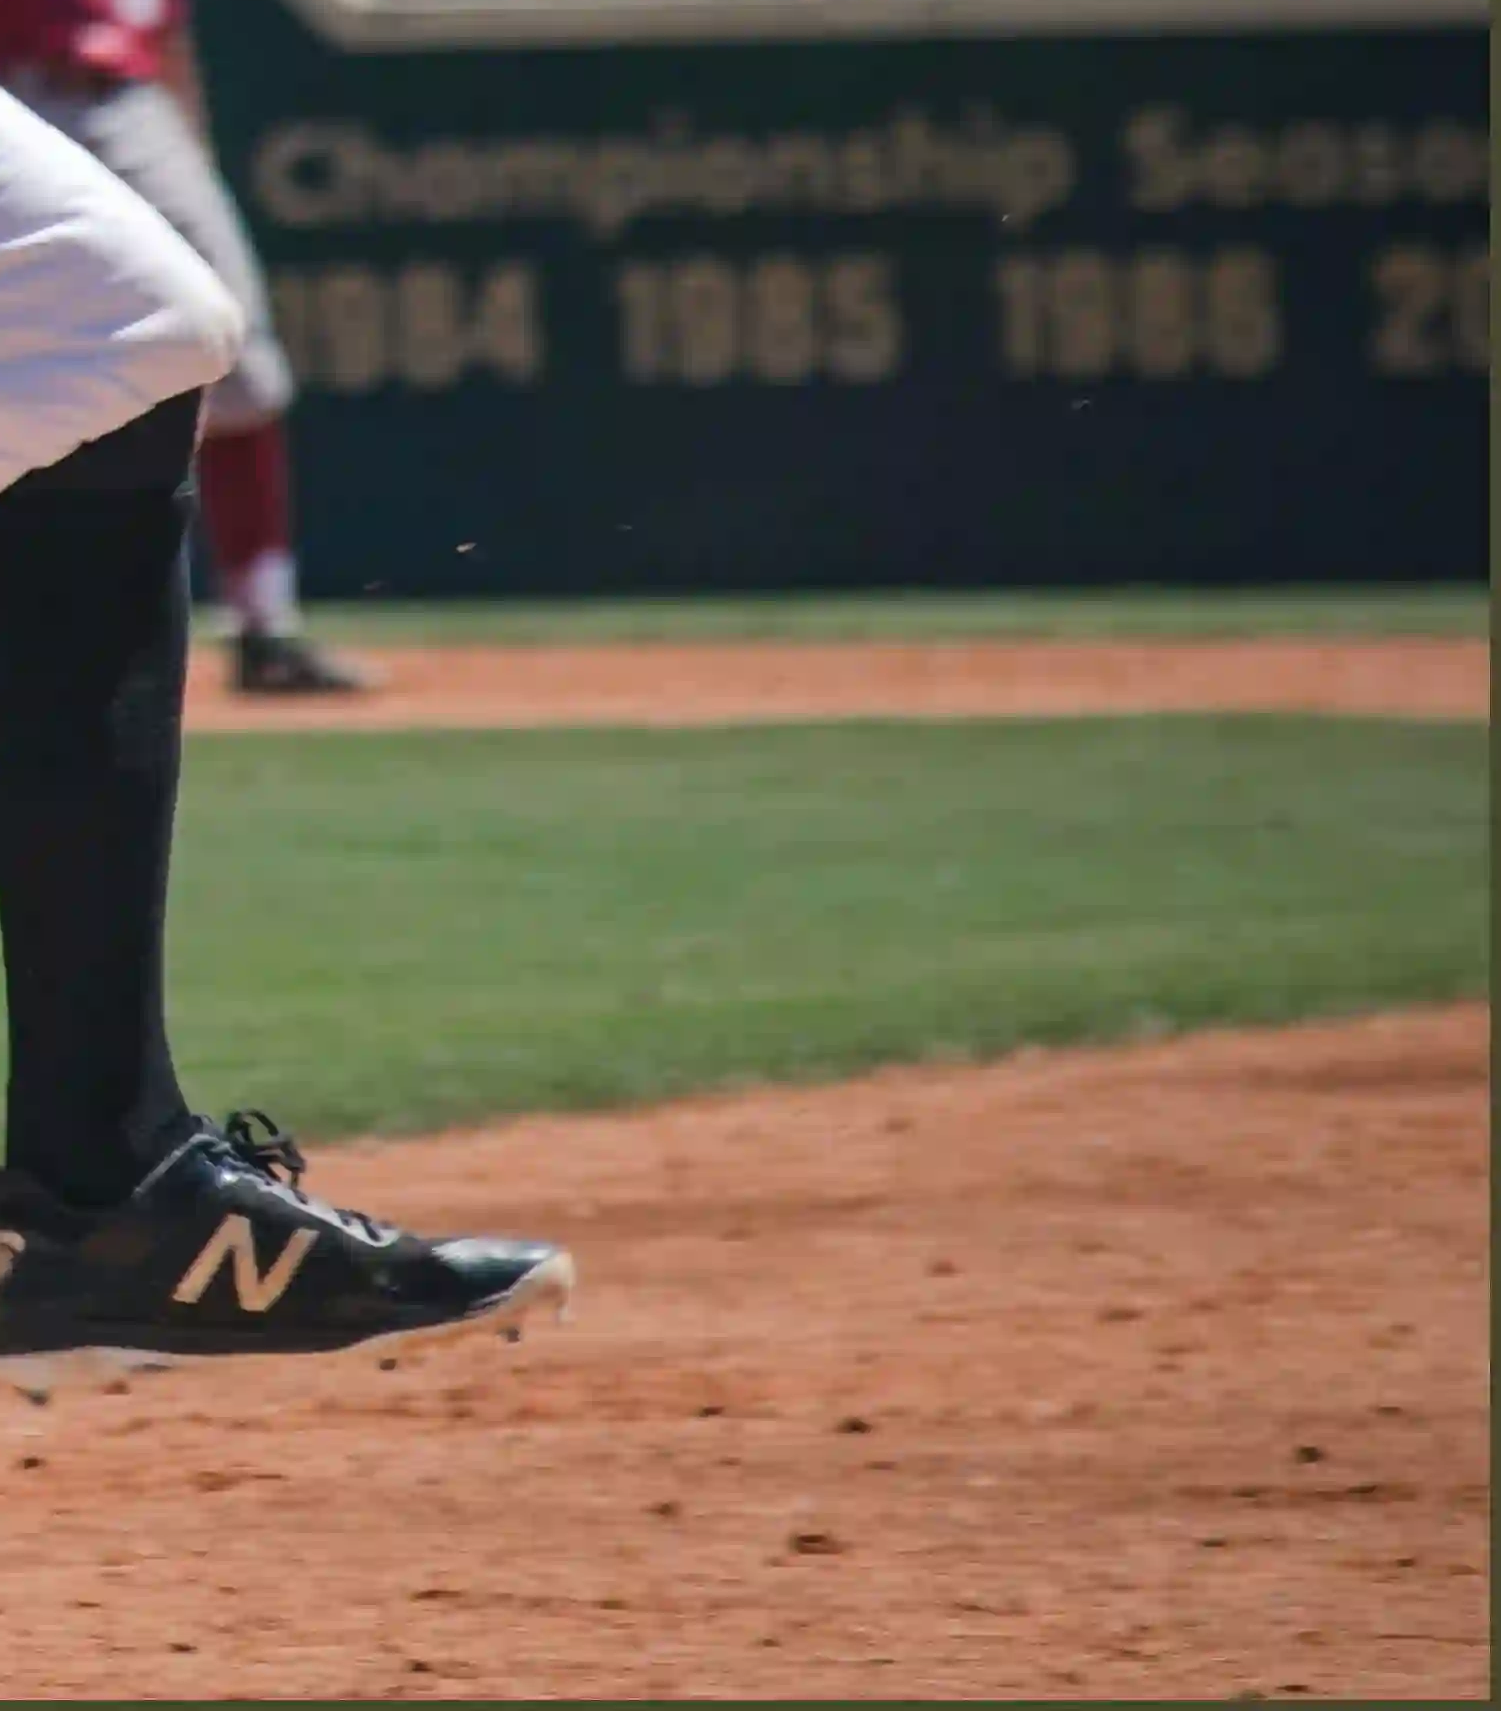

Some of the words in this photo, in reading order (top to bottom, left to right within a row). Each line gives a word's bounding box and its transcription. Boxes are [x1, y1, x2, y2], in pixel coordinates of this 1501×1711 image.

[252, 107, 1078, 237] Championship
[1124, 104, 1489, 211] Seaso
[278, 259, 540, 387] 1984
[618, 253, 902, 383] 1985
[172, 1213, 319, 1312] N
